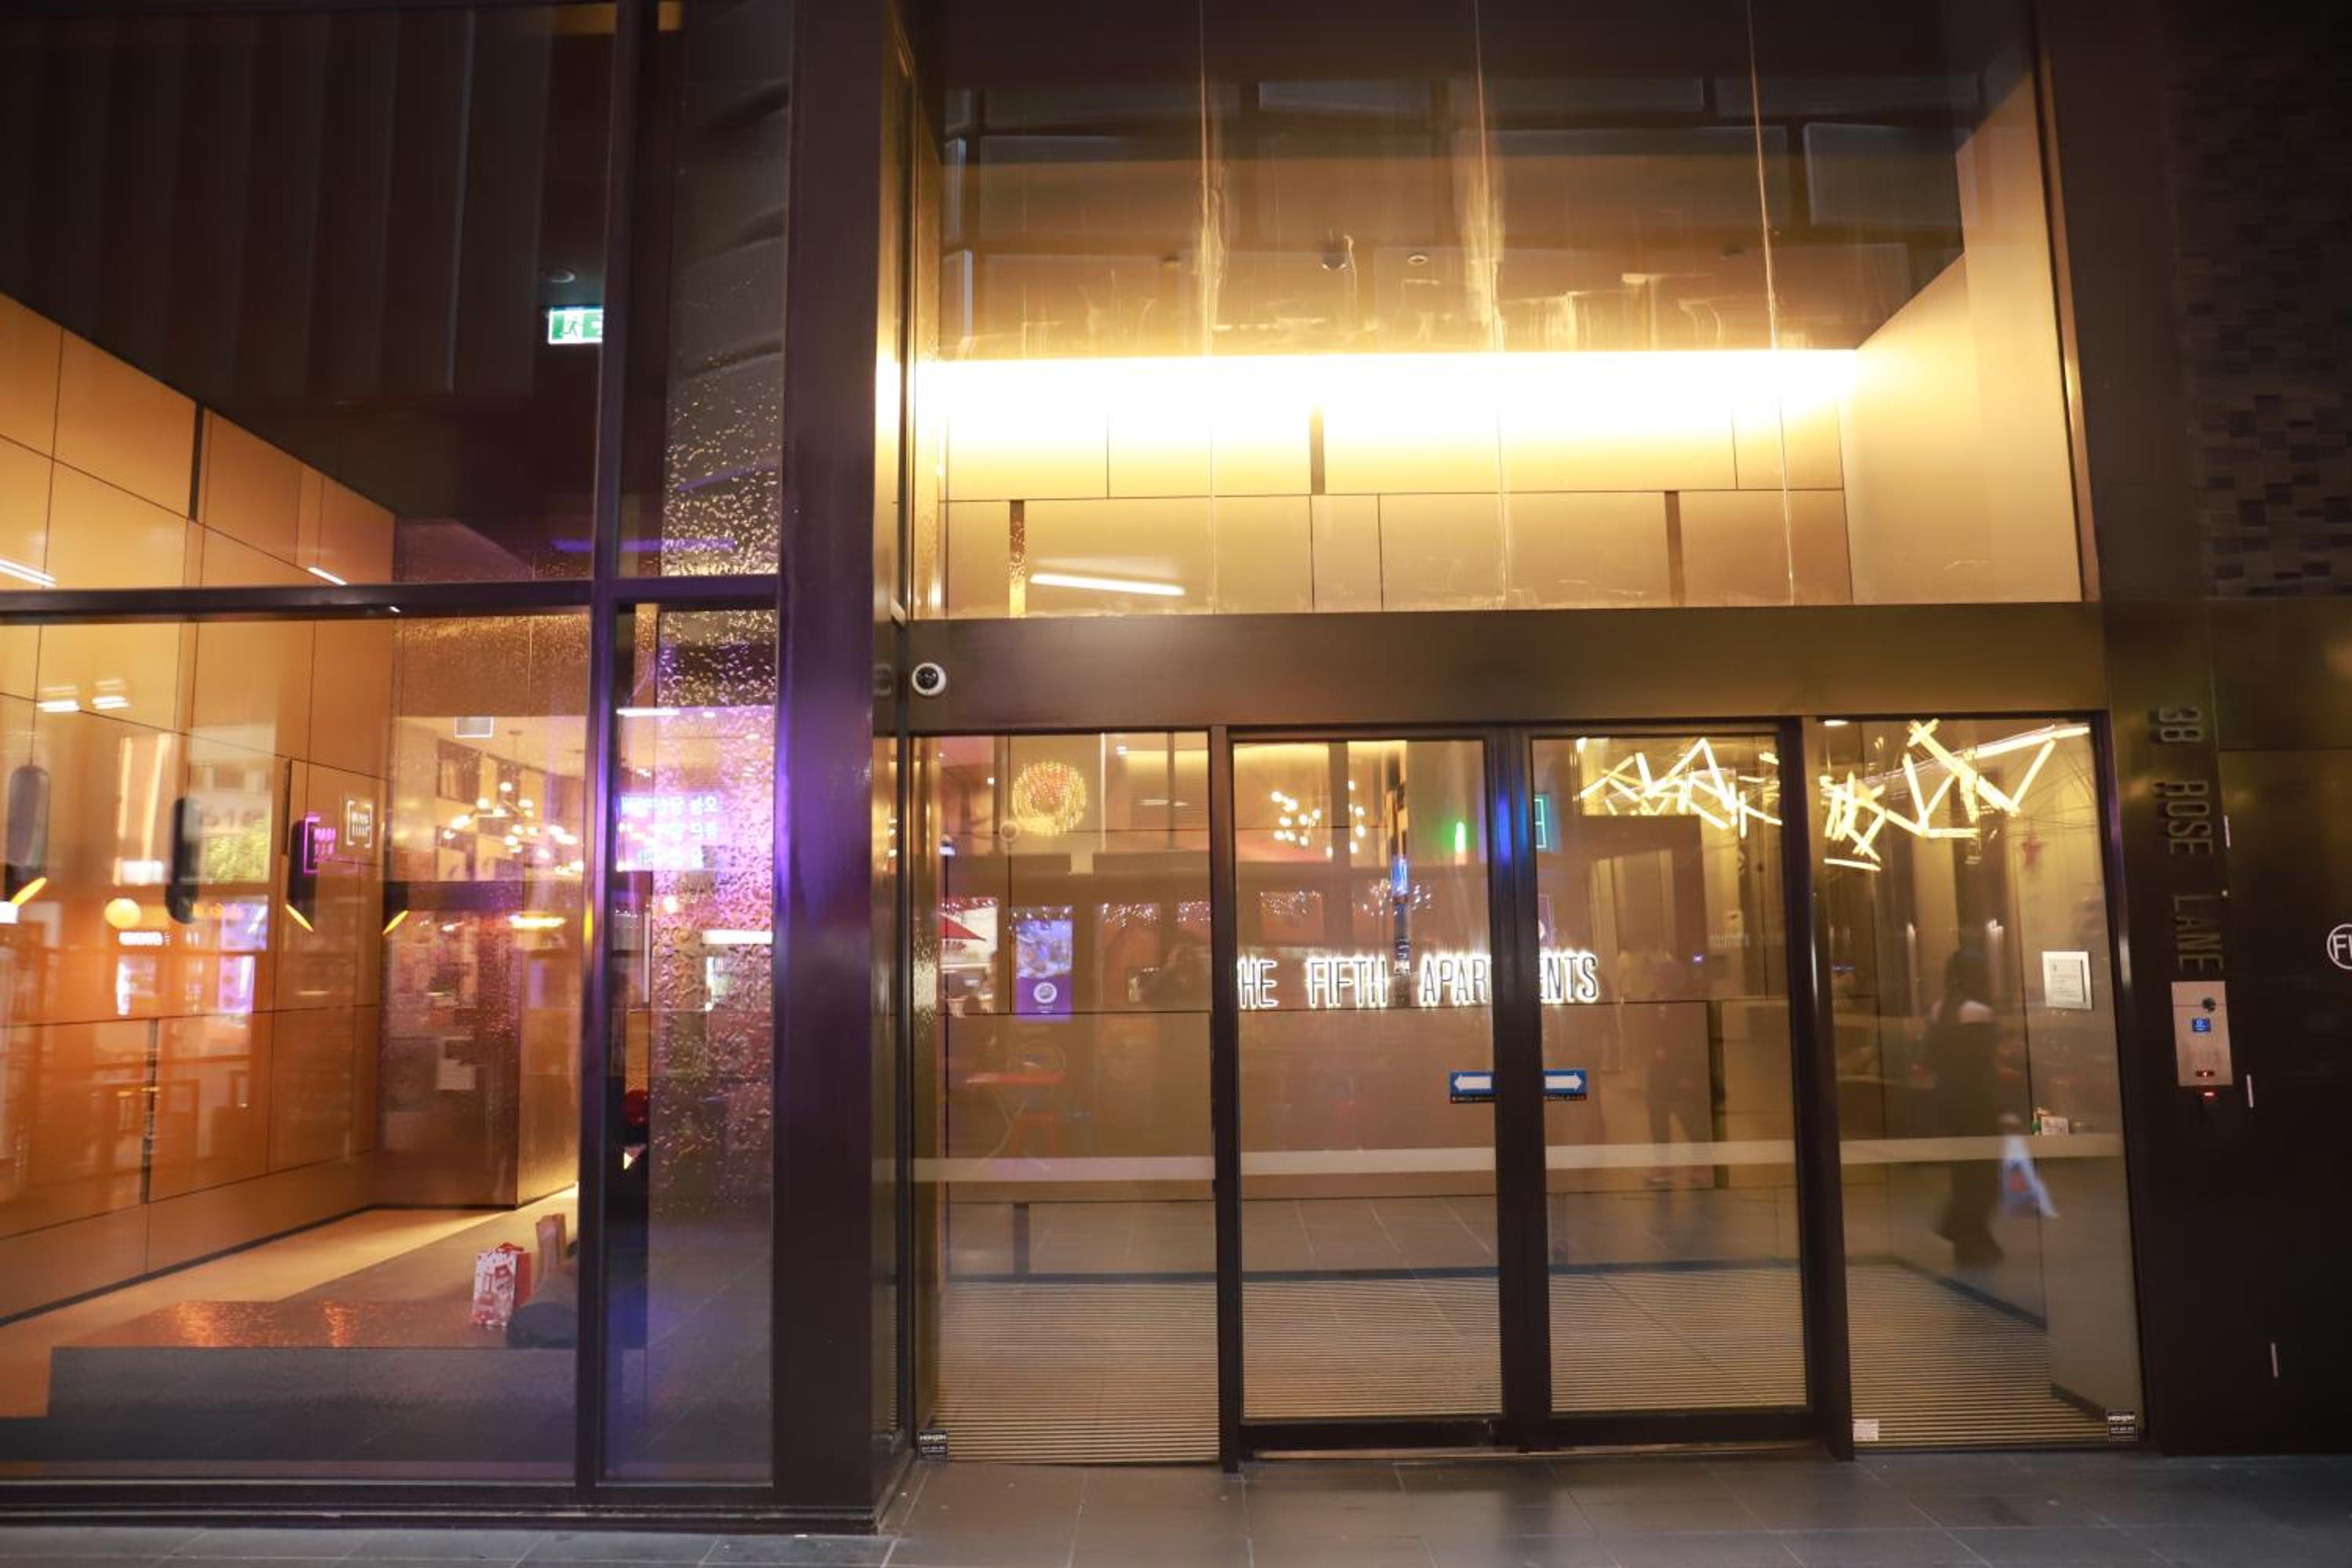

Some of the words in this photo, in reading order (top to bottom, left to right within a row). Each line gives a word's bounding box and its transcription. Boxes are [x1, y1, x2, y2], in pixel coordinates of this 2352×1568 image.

[2165, 779, 2213, 854] ROSE
[2172, 893, 2224, 971] LANE
[1239, 959, 1278, 1008] HE
[1307, 957, 1388, 1007] FIFTH
